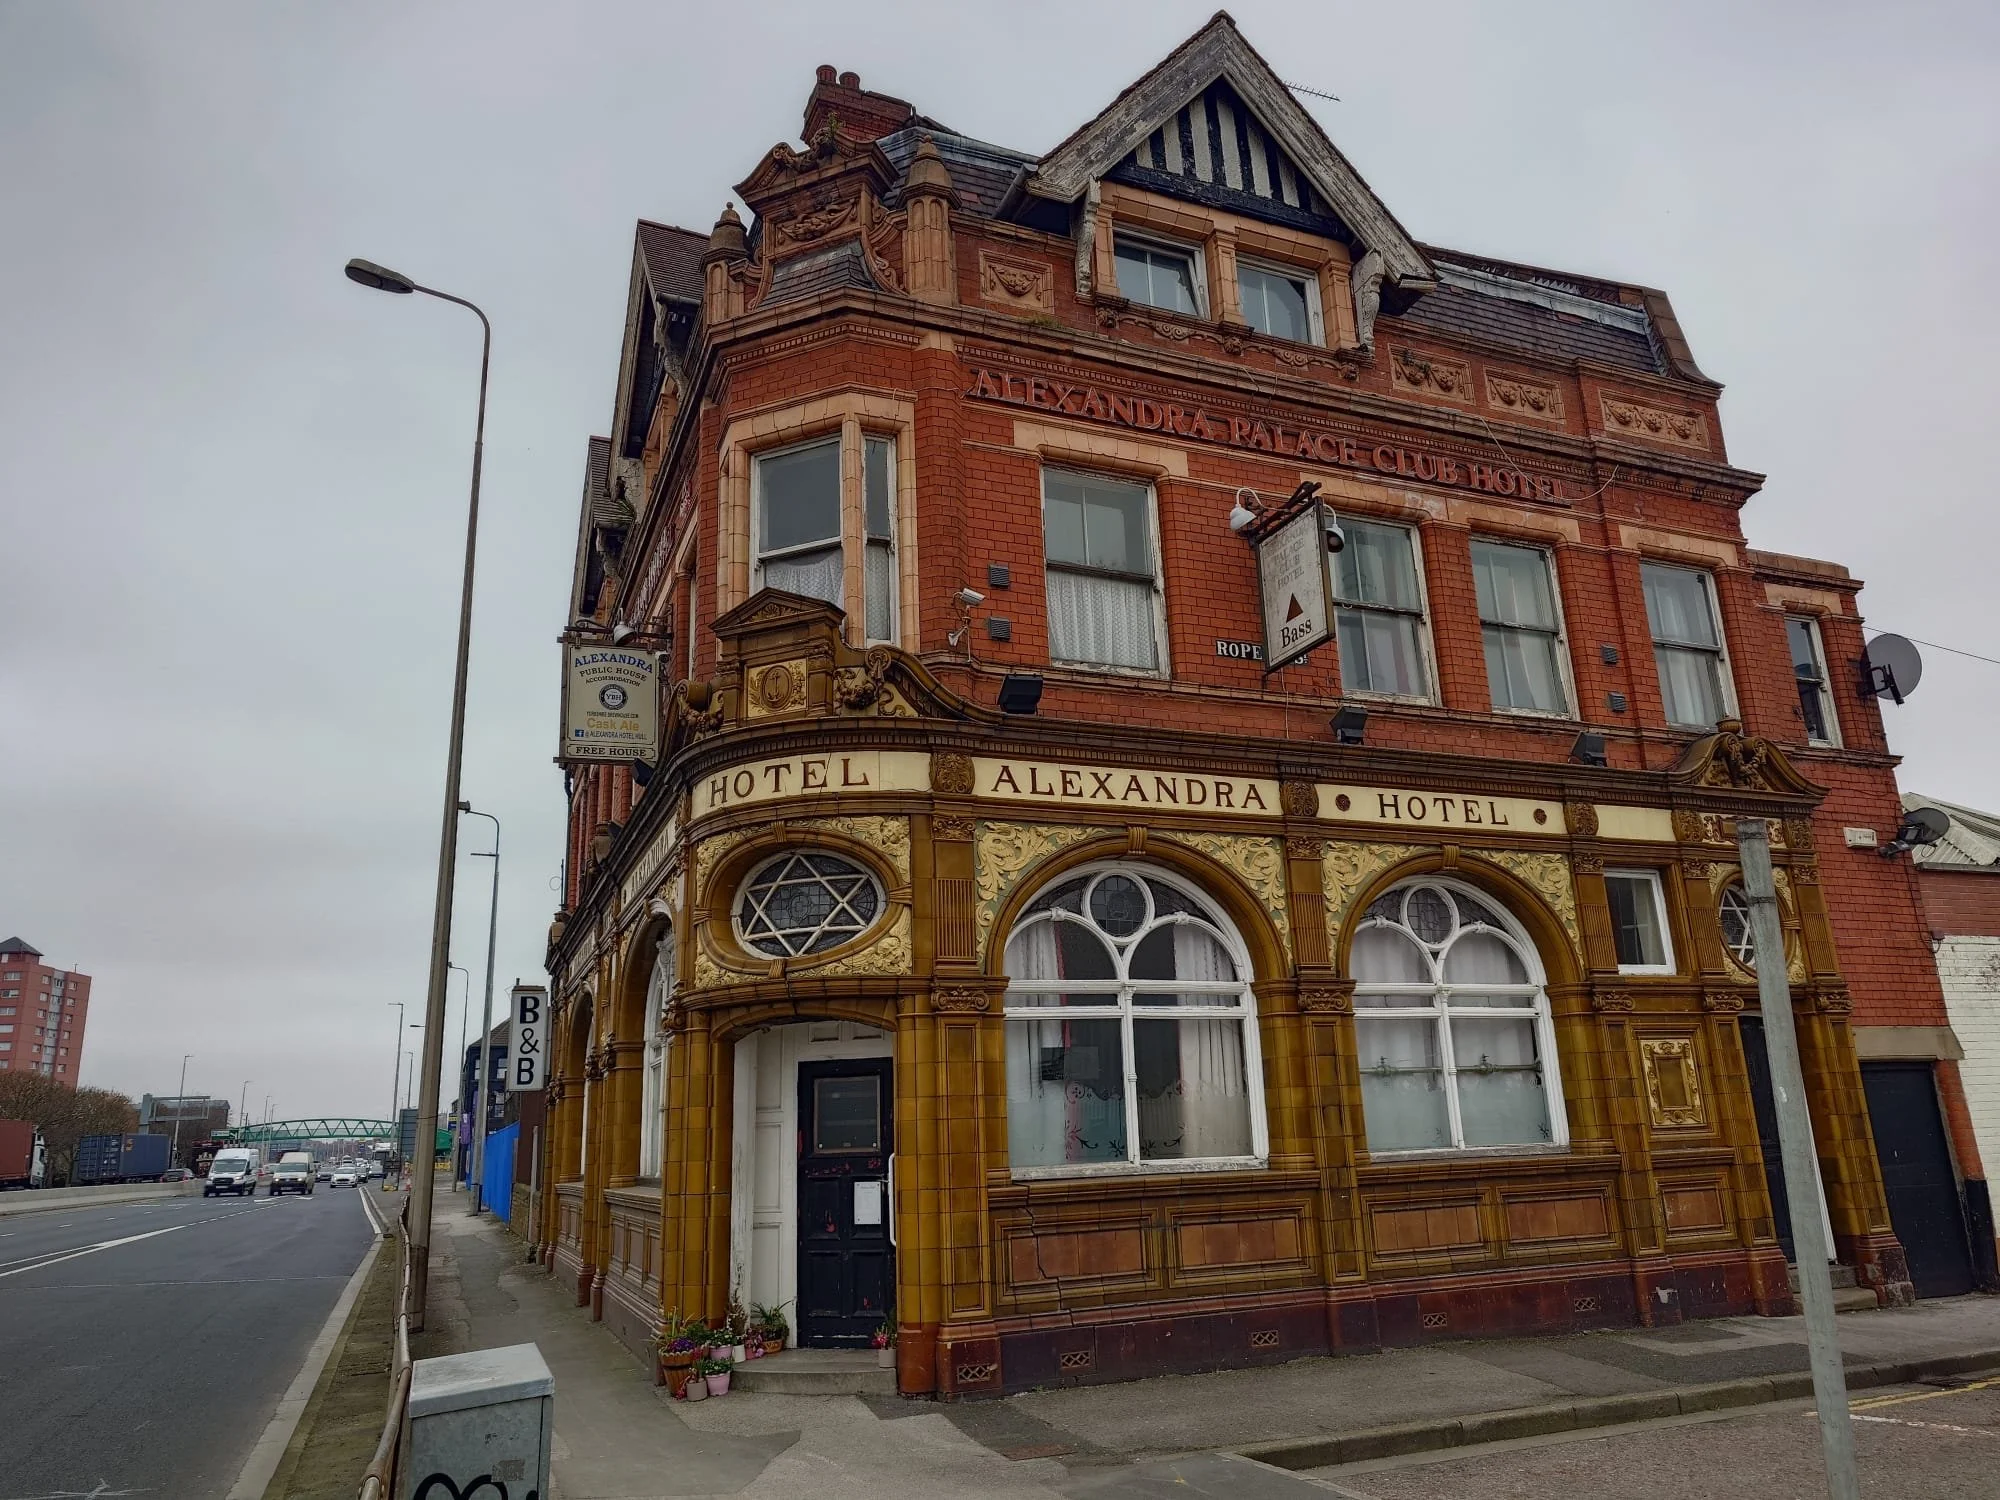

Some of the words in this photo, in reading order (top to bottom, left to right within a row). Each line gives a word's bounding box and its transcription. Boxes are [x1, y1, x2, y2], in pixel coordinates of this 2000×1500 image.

[969, 367, 1215, 441] ALEXANDRA
[1226, 415, 1358, 465] PALACE
[1373, 445, 1459, 484] CLUB
[1467, 462, 1569, 504] HOTEL
[1280, 619, 1312, 648] Bass
[574, 652, 653, 673] ALEXANDRA
[579, 666, 613, 677] PUBLIC
[616, 667, 647, 682] HOUSE
[585, 675, 641, 687] ACCOMMODATION
[587, 717, 616, 730] Cask
[620, 719, 640, 731] Ale
[590, 730, 618, 739] ALEXANDRA
[575, 746, 607, 755] FREE
[609, 747, 646, 757] HOUSE
[709, 757, 870, 809] HOTEL
[991, 764, 1268, 811] ALEXANDRA
[1377, 793, 1510, 826] HOTEL
[516, 995, 541, 1086] B&B
